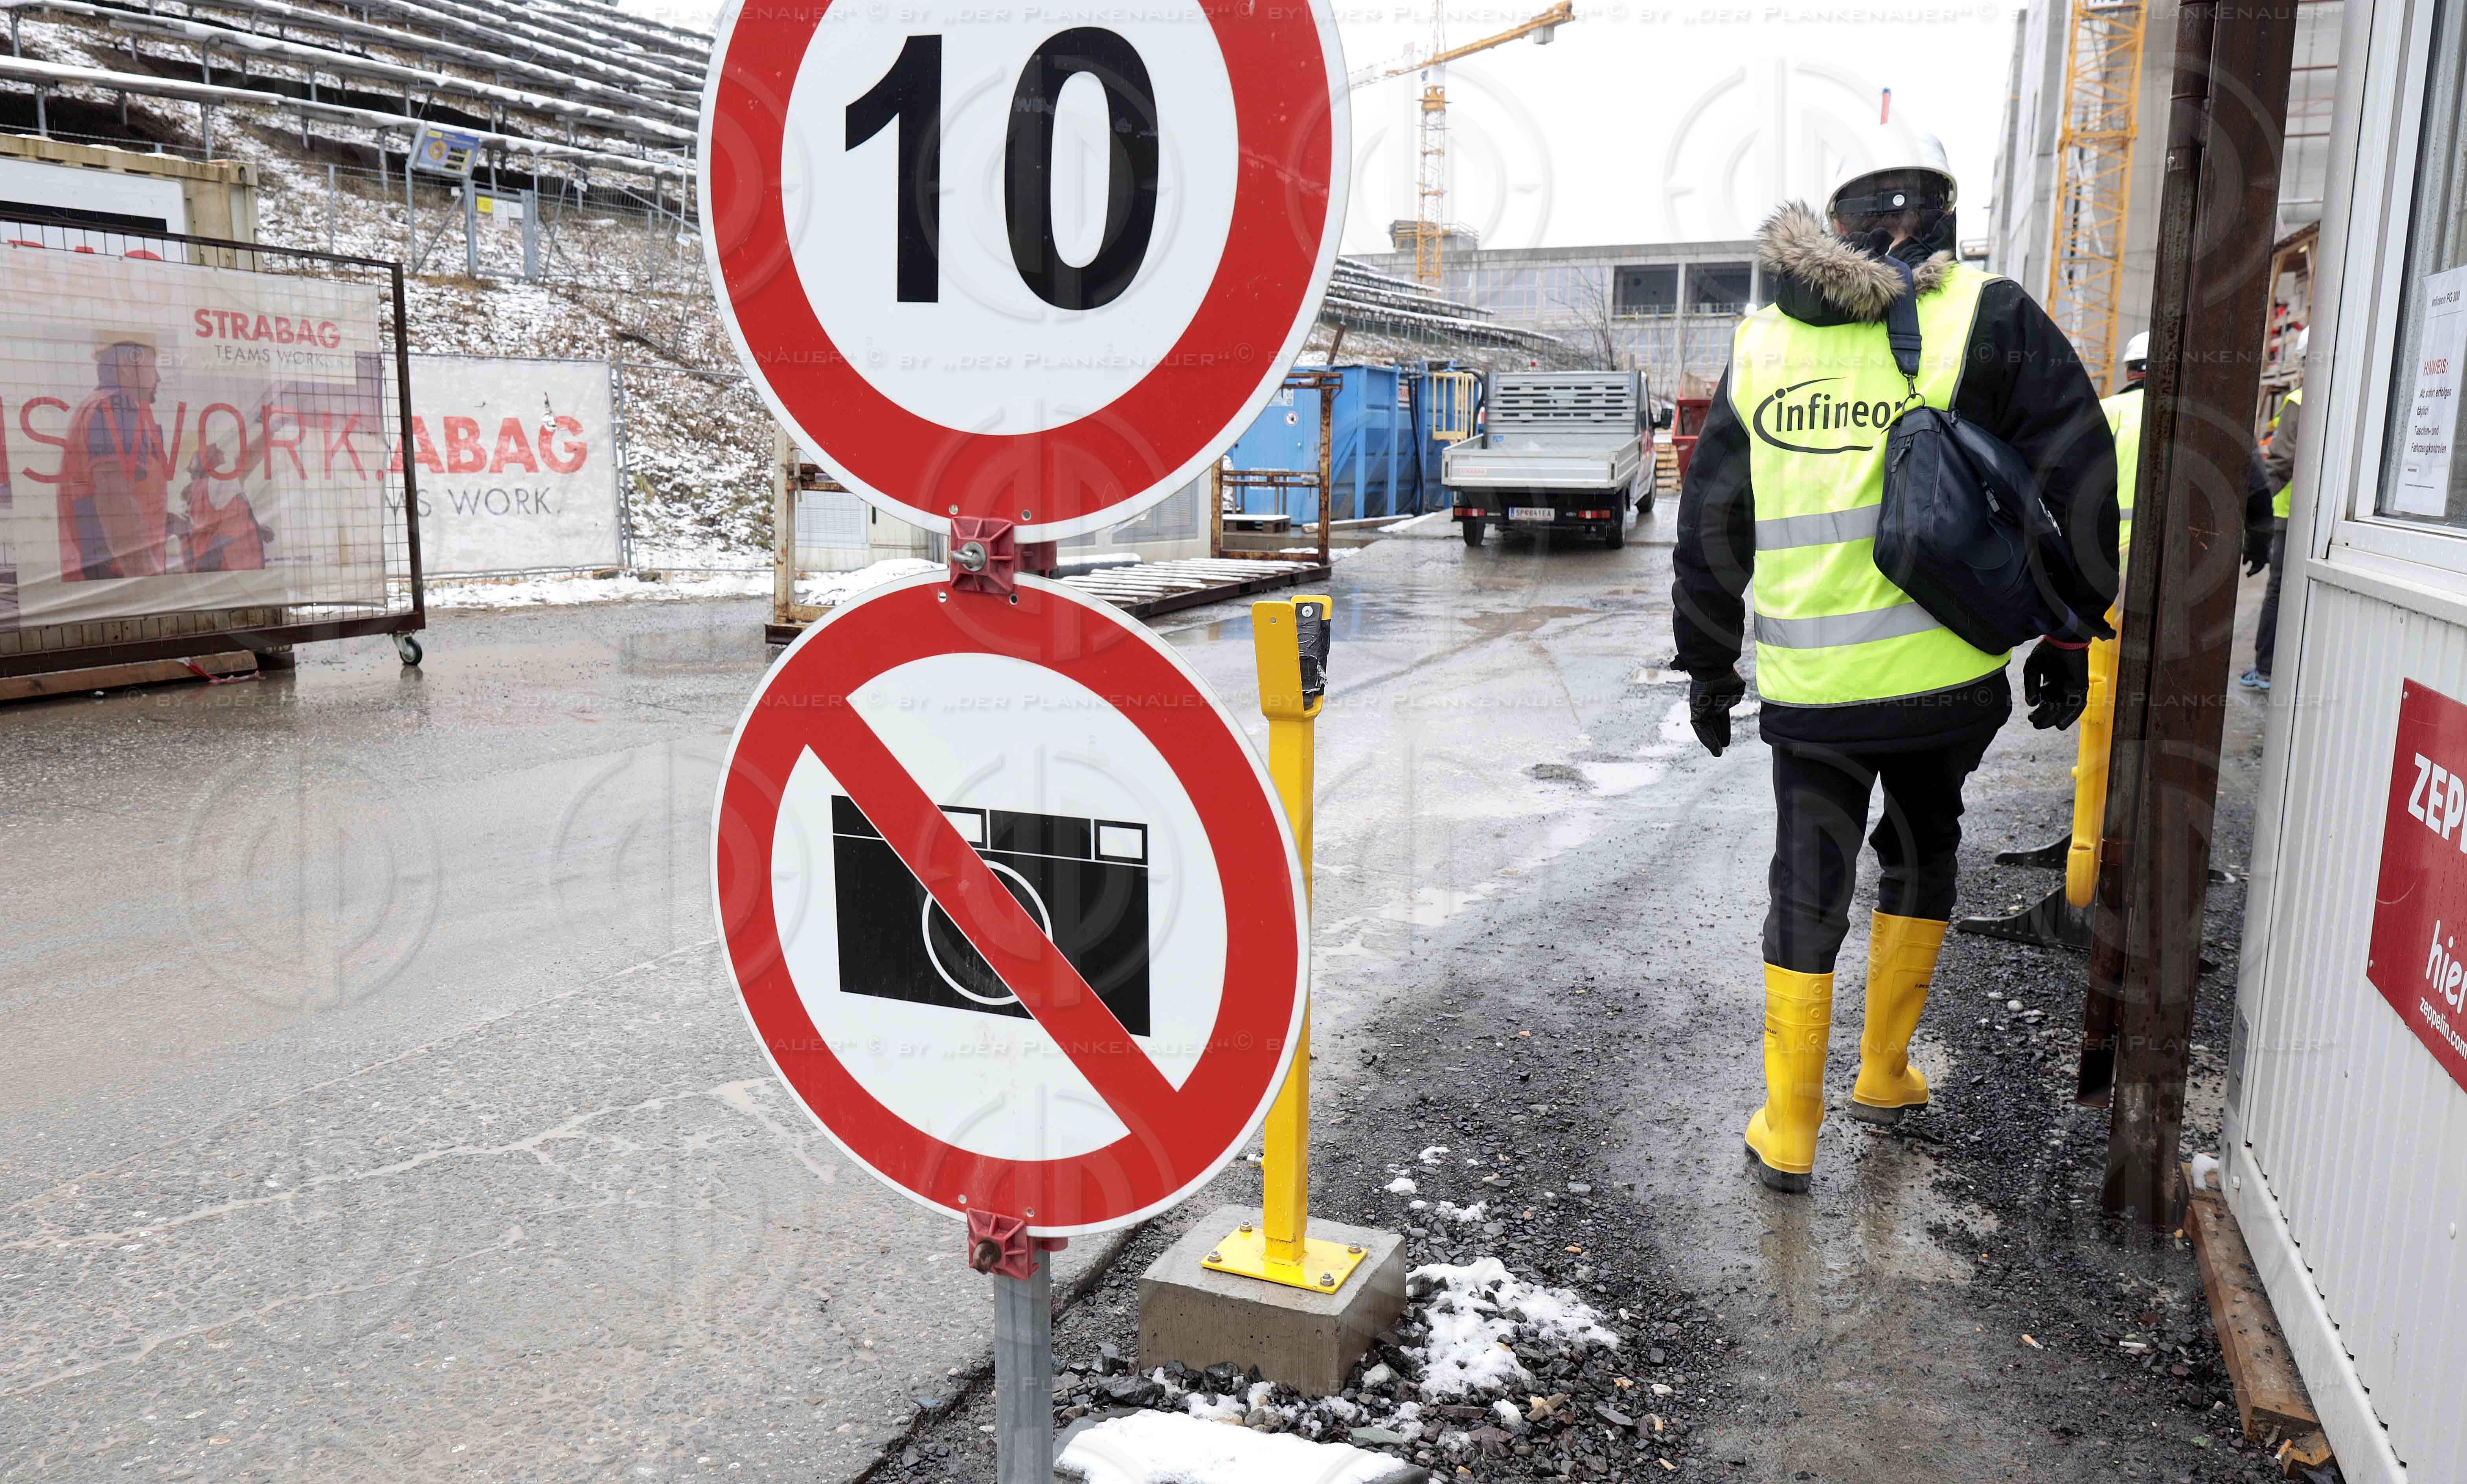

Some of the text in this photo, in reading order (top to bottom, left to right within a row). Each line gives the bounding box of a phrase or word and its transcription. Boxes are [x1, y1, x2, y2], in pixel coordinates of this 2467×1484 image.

[846, 27, 1159, 310] 10
[2447, 292, 2453, 304] PG
[195, 308, 340, 349] STRABAG
[215, 345, 270, 362] TEAMS
[2423, 358, 2449, 376] HINWEIS:
[2436, 386, 2452, 399] erfolgen
[0, 396, 384, 484] S WORK.
[390, 415, 587, 474] ABAG
[448, 487, 560, 515] WORK.
[2419, 996, 2467, 1060] zeppelin.com
